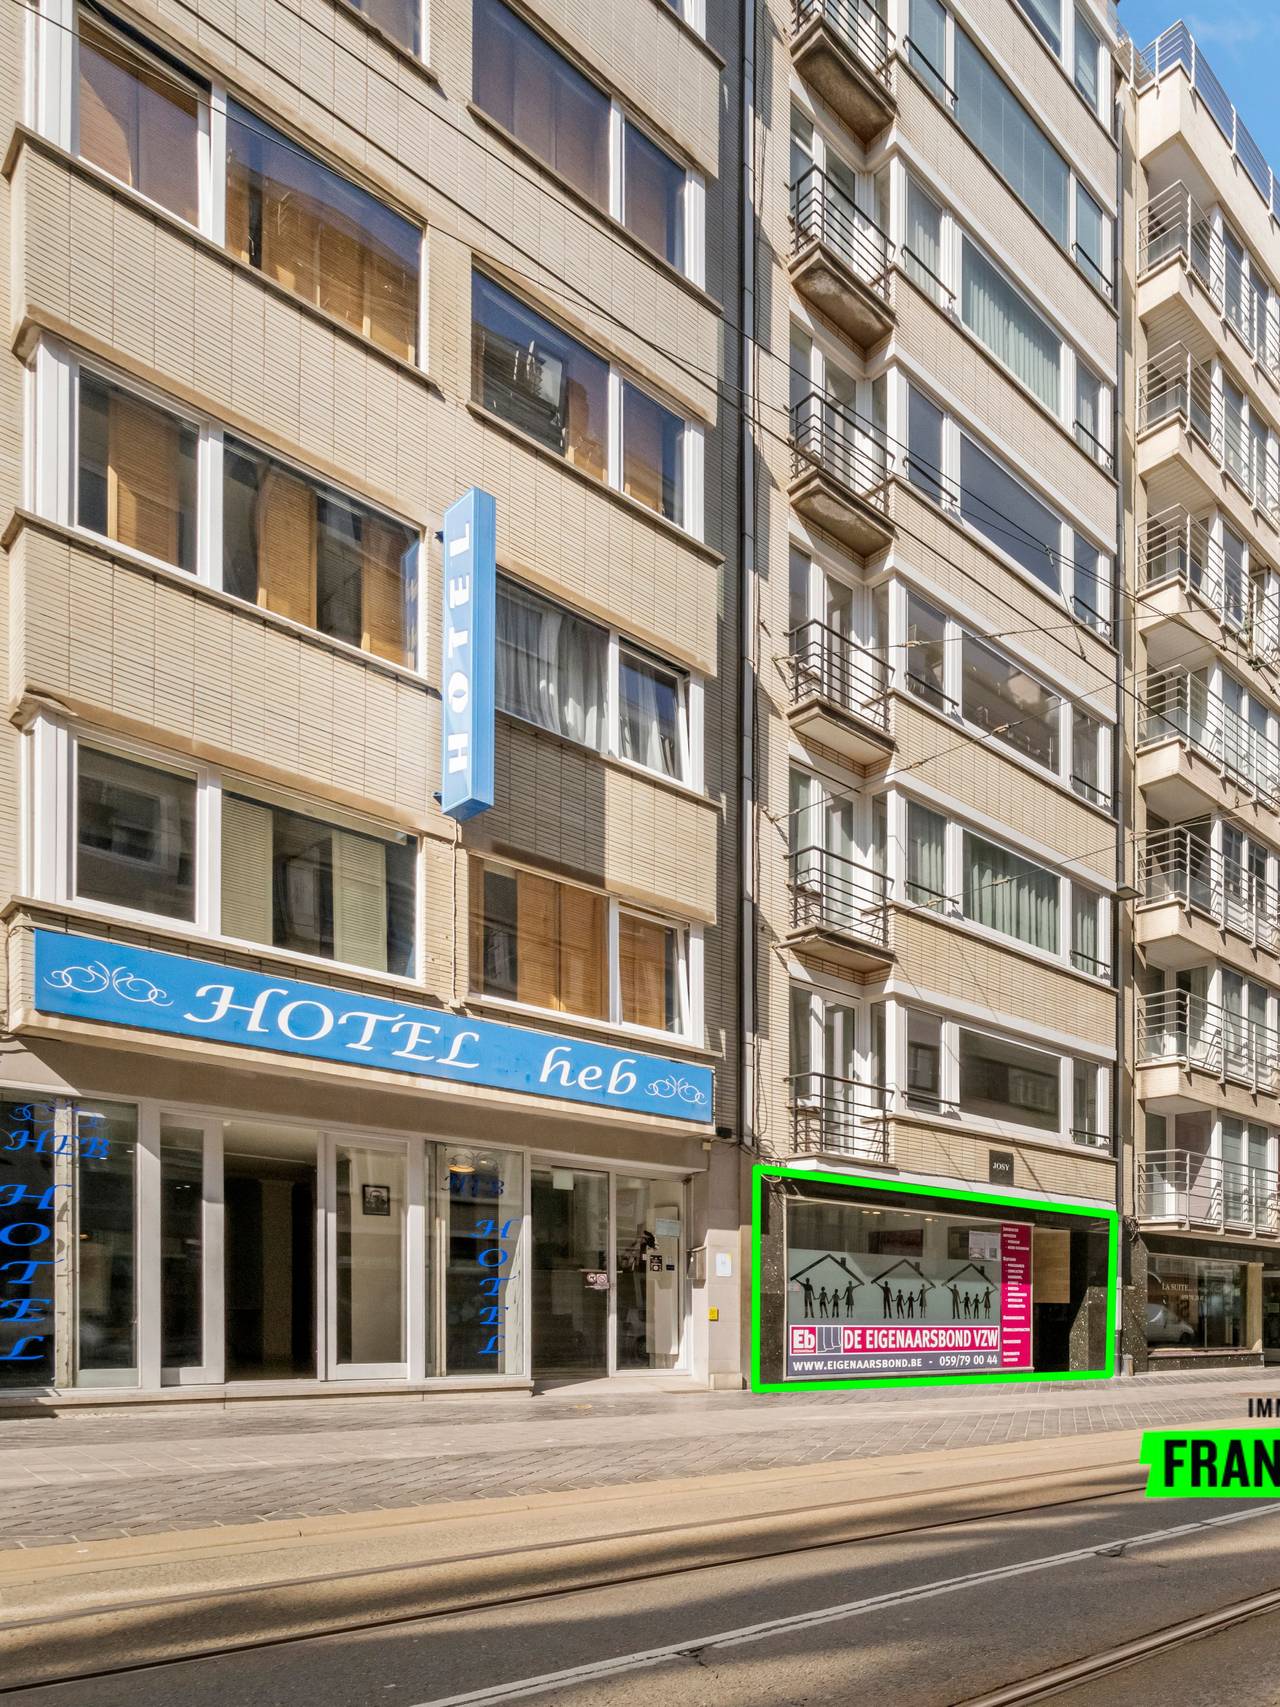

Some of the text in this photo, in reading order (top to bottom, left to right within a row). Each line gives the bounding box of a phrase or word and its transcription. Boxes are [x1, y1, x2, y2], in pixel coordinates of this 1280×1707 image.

[448, 522, 471, 775] HOTEL
[183, 984, 638, 1095] HOTEL heb
[4, 1130, 110, 1159] HEB
[0, 1184, 72, 1361] HOTEL
[467, 1218, 521, 1354] HOTEL
[793, 1329, 815, 1349] Eb
[793, 1359, 922, 1371] WWW.EIGENAARSBOND.BE
[939, 1355, 970, 1367] 059/79
[973, 1355, 984, 1365] 00
[987, 1354, 998, 1365] 44
[844, 1329, 998, 1349] DE EIGENAARSBOND VZW
